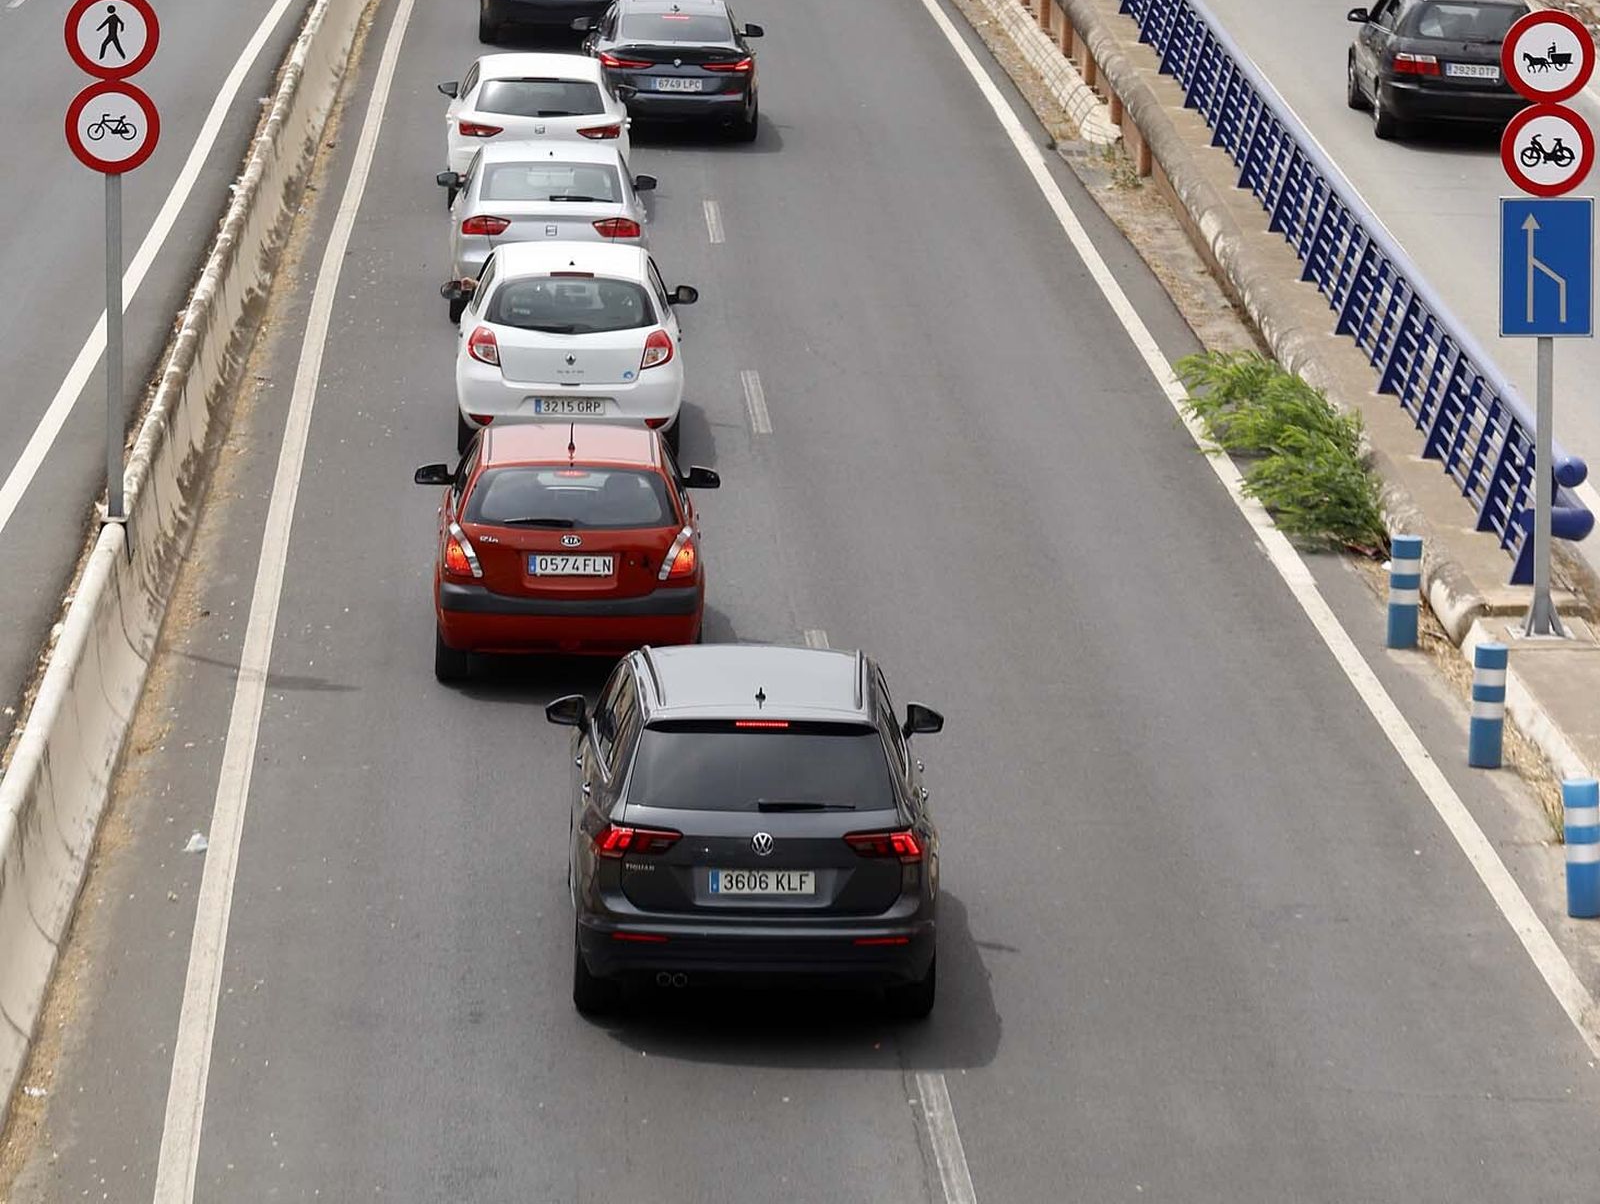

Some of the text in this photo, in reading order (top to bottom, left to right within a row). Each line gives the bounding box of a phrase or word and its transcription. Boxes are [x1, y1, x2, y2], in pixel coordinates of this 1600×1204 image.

[658, 79, 681, 89] 6749
[543, 400, 601, 413] 3215 GRP
[539, 557, 612, 573] 0574 FLN
[723, 873, 810, 892] 3606 KLF
